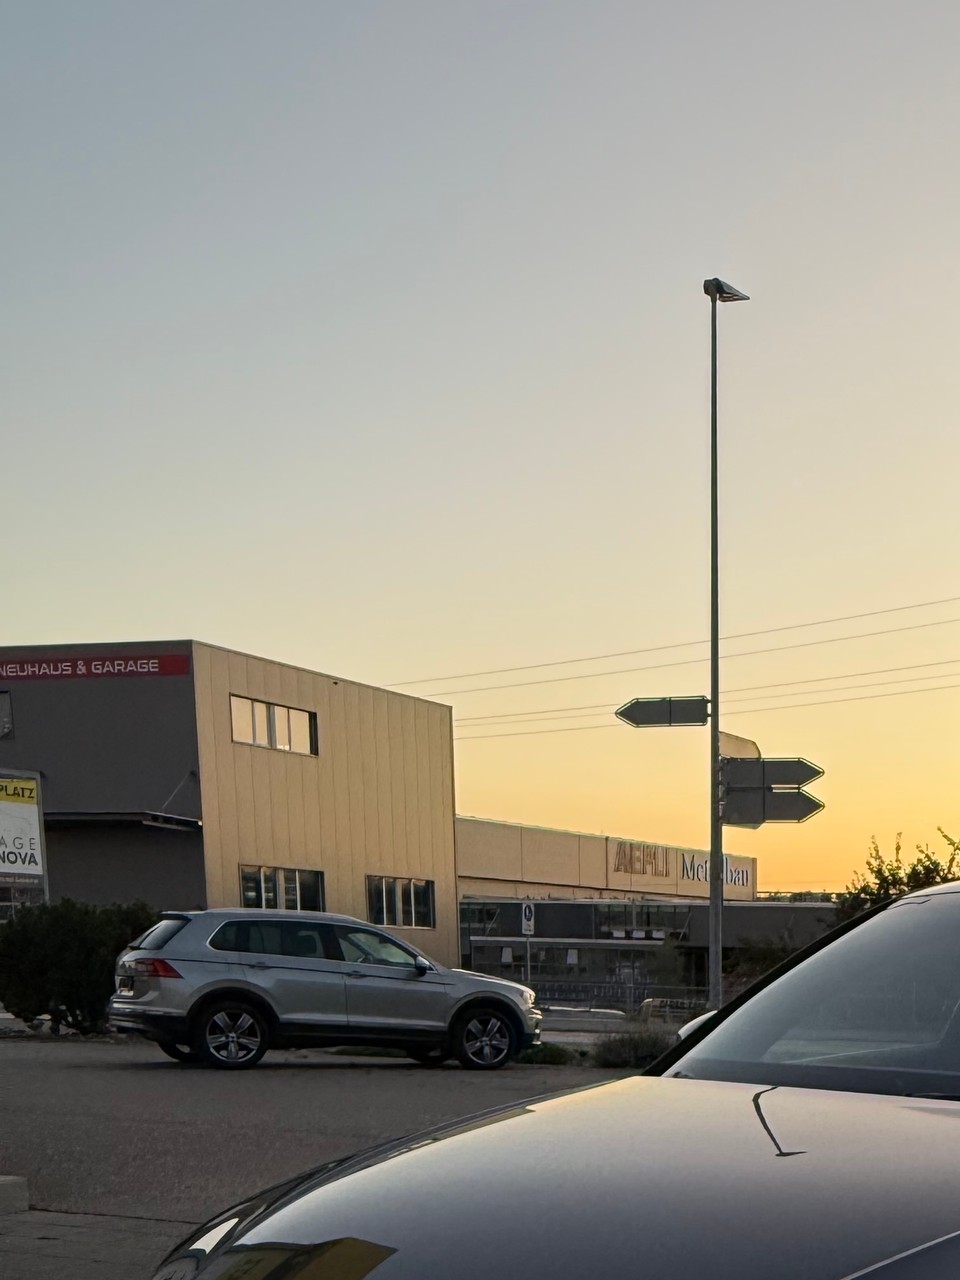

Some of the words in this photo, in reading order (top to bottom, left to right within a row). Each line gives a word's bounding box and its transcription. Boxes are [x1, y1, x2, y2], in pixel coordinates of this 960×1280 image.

[76, 660, 87, 675] &
[91, 659, 159, 674] GARAGE
[681, 853, 749, 887] Metbau
